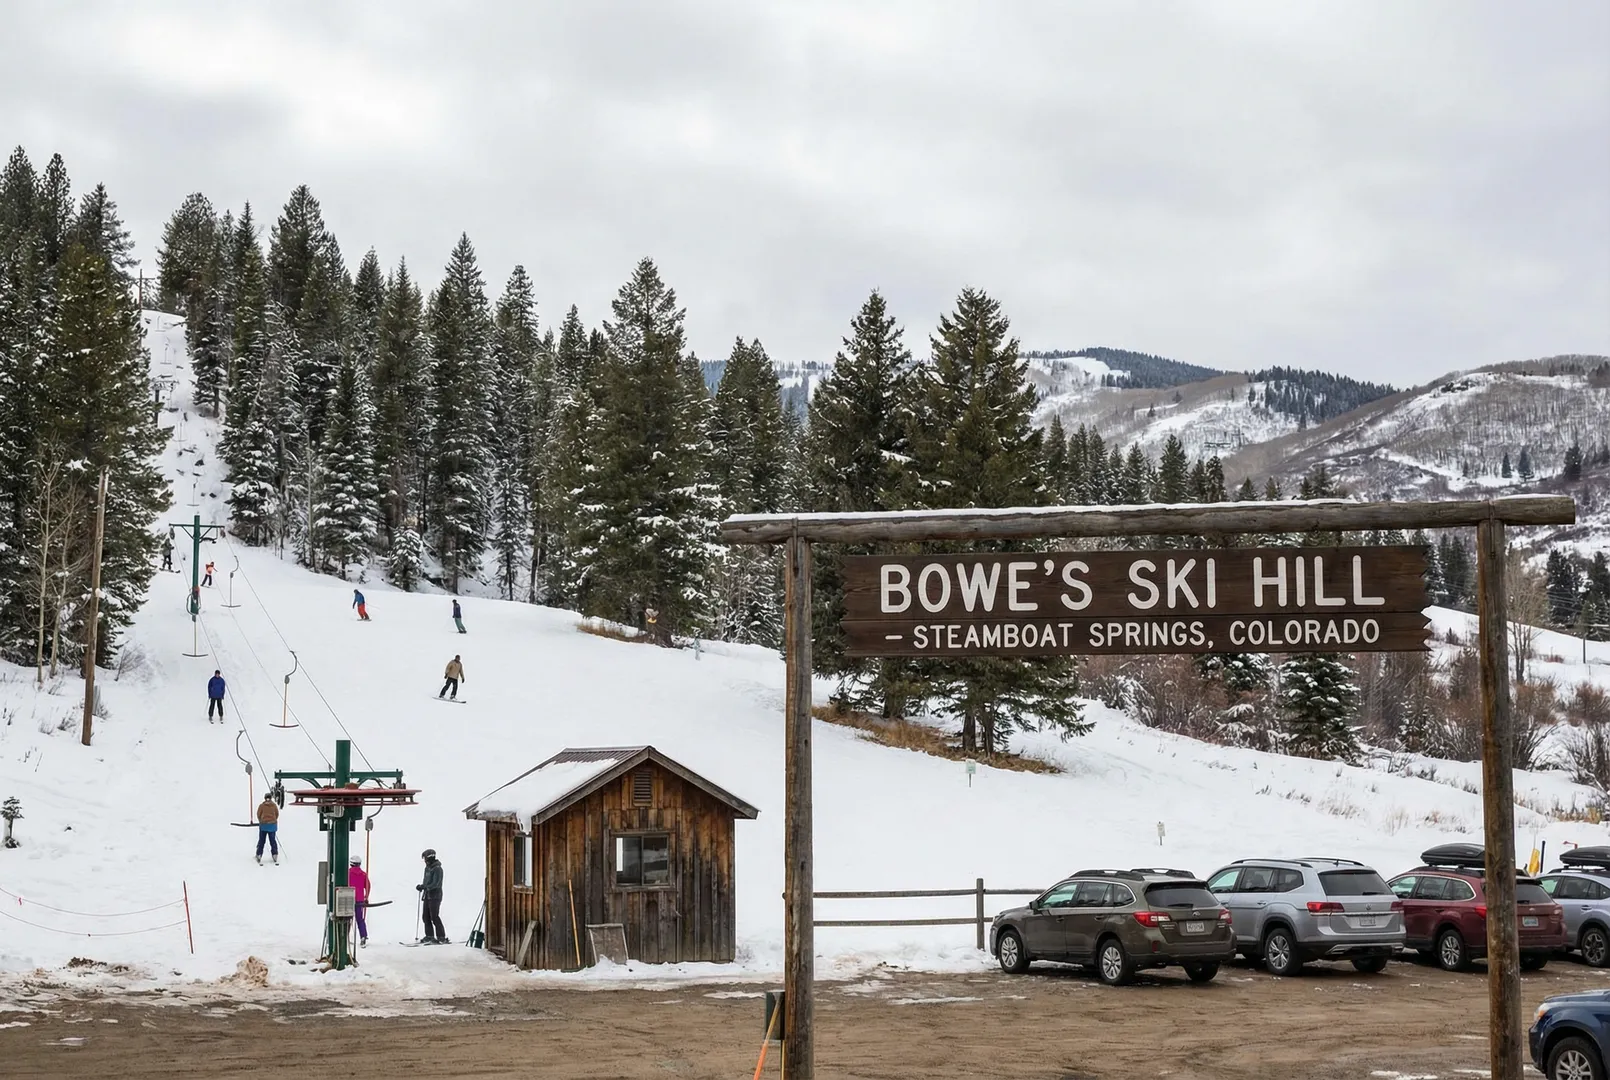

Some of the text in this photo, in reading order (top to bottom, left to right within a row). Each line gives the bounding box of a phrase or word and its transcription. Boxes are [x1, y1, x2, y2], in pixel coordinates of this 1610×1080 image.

[880, 554, 1386, 614] BOWE'S SKI HILL
[913, 623, 1074, 649] STEAMBOAT
[1088, 621, 1214, 649] SPRINGS,
[1229, 618, 1380, 646] COLORADO
